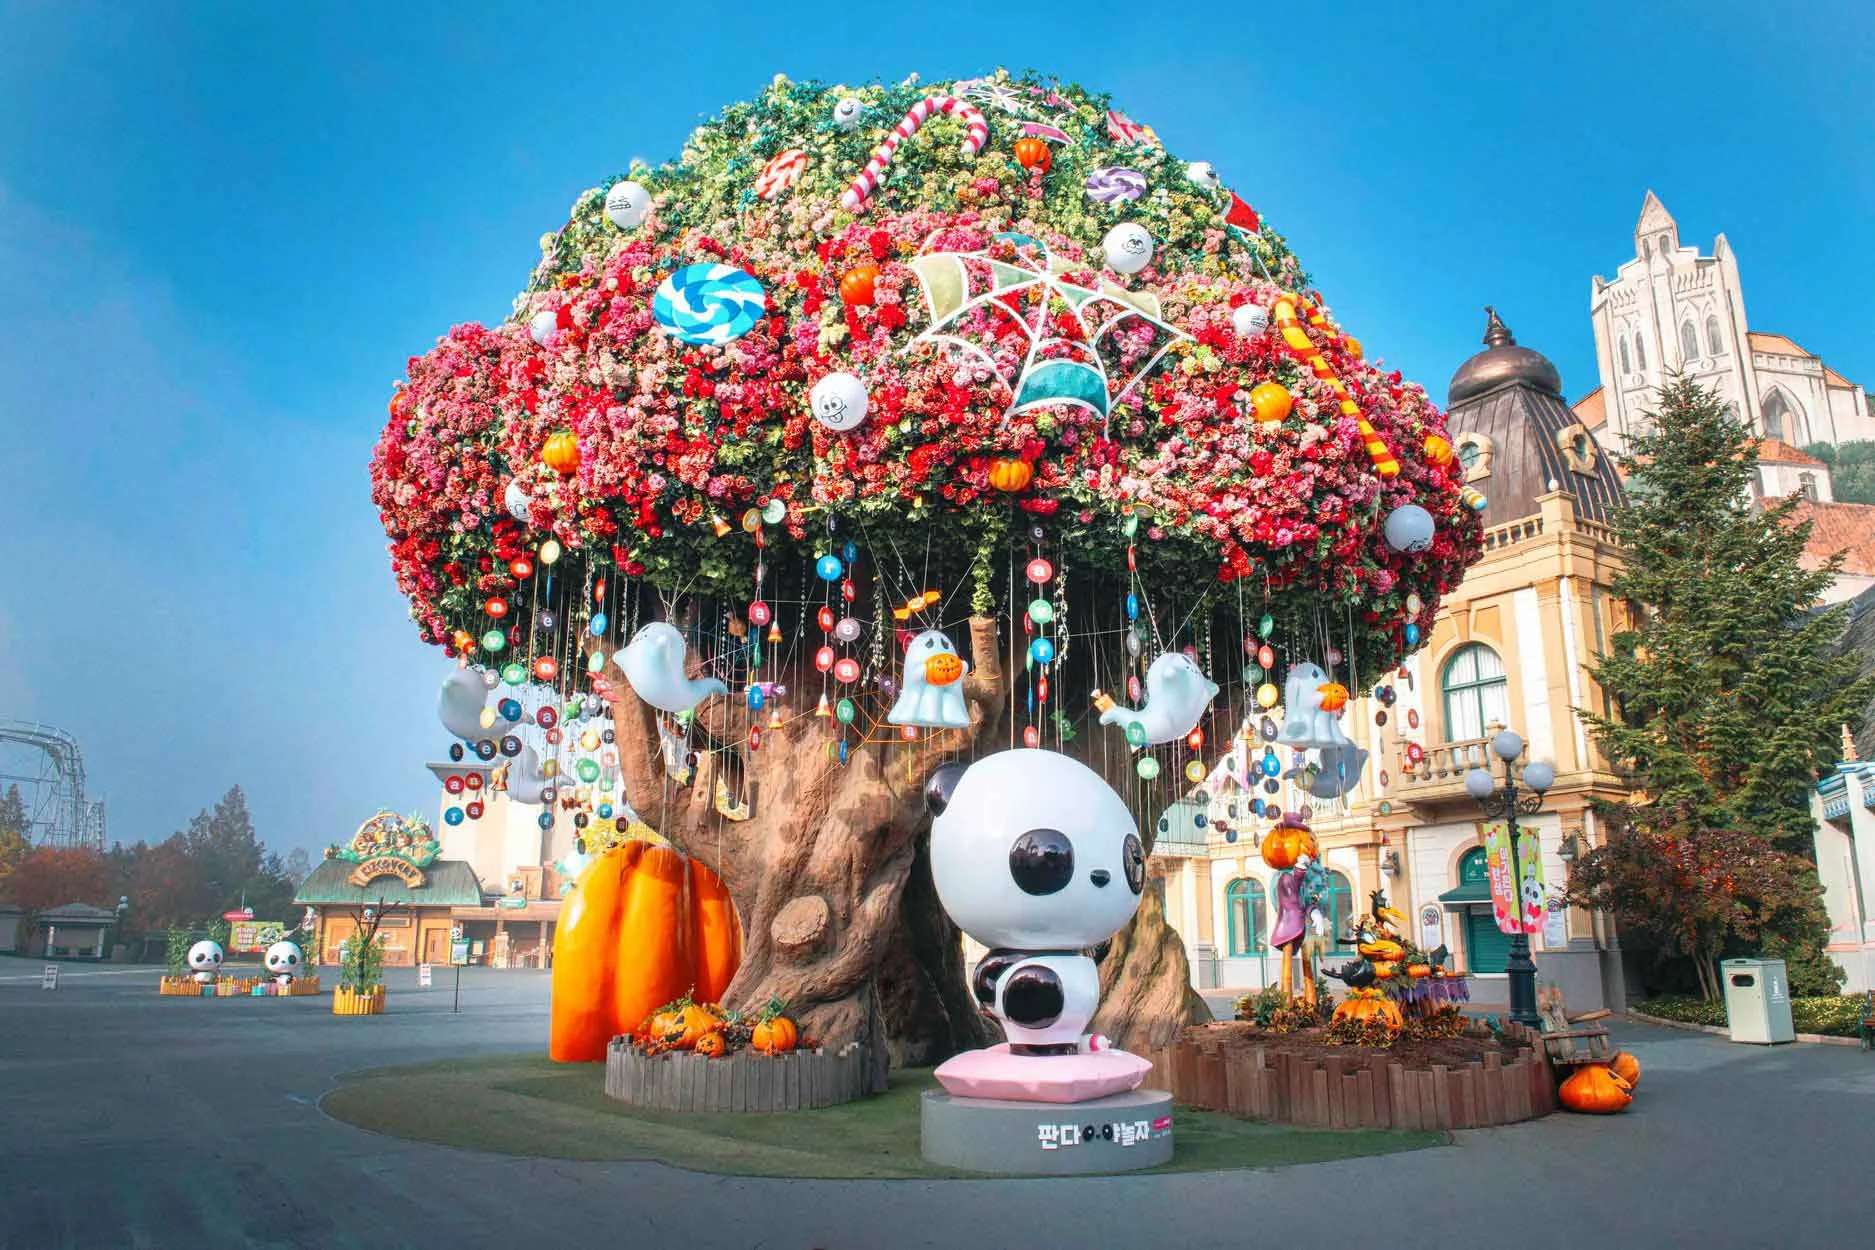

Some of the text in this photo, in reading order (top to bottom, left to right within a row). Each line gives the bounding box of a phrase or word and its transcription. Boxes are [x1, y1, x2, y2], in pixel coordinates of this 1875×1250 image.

[755, 607, 765, 618] a
[543, 617, 552, 627] e
[543, 712, 552, 722] a
[482, 745, 491, 754] e
[507, 740, 516, 750] e
[450, 780, 460, 790] a
[544, 791, 553, 800] e
[470, 806, 480, 815] a
[1038, 1123, 1082, 1150] 판다
